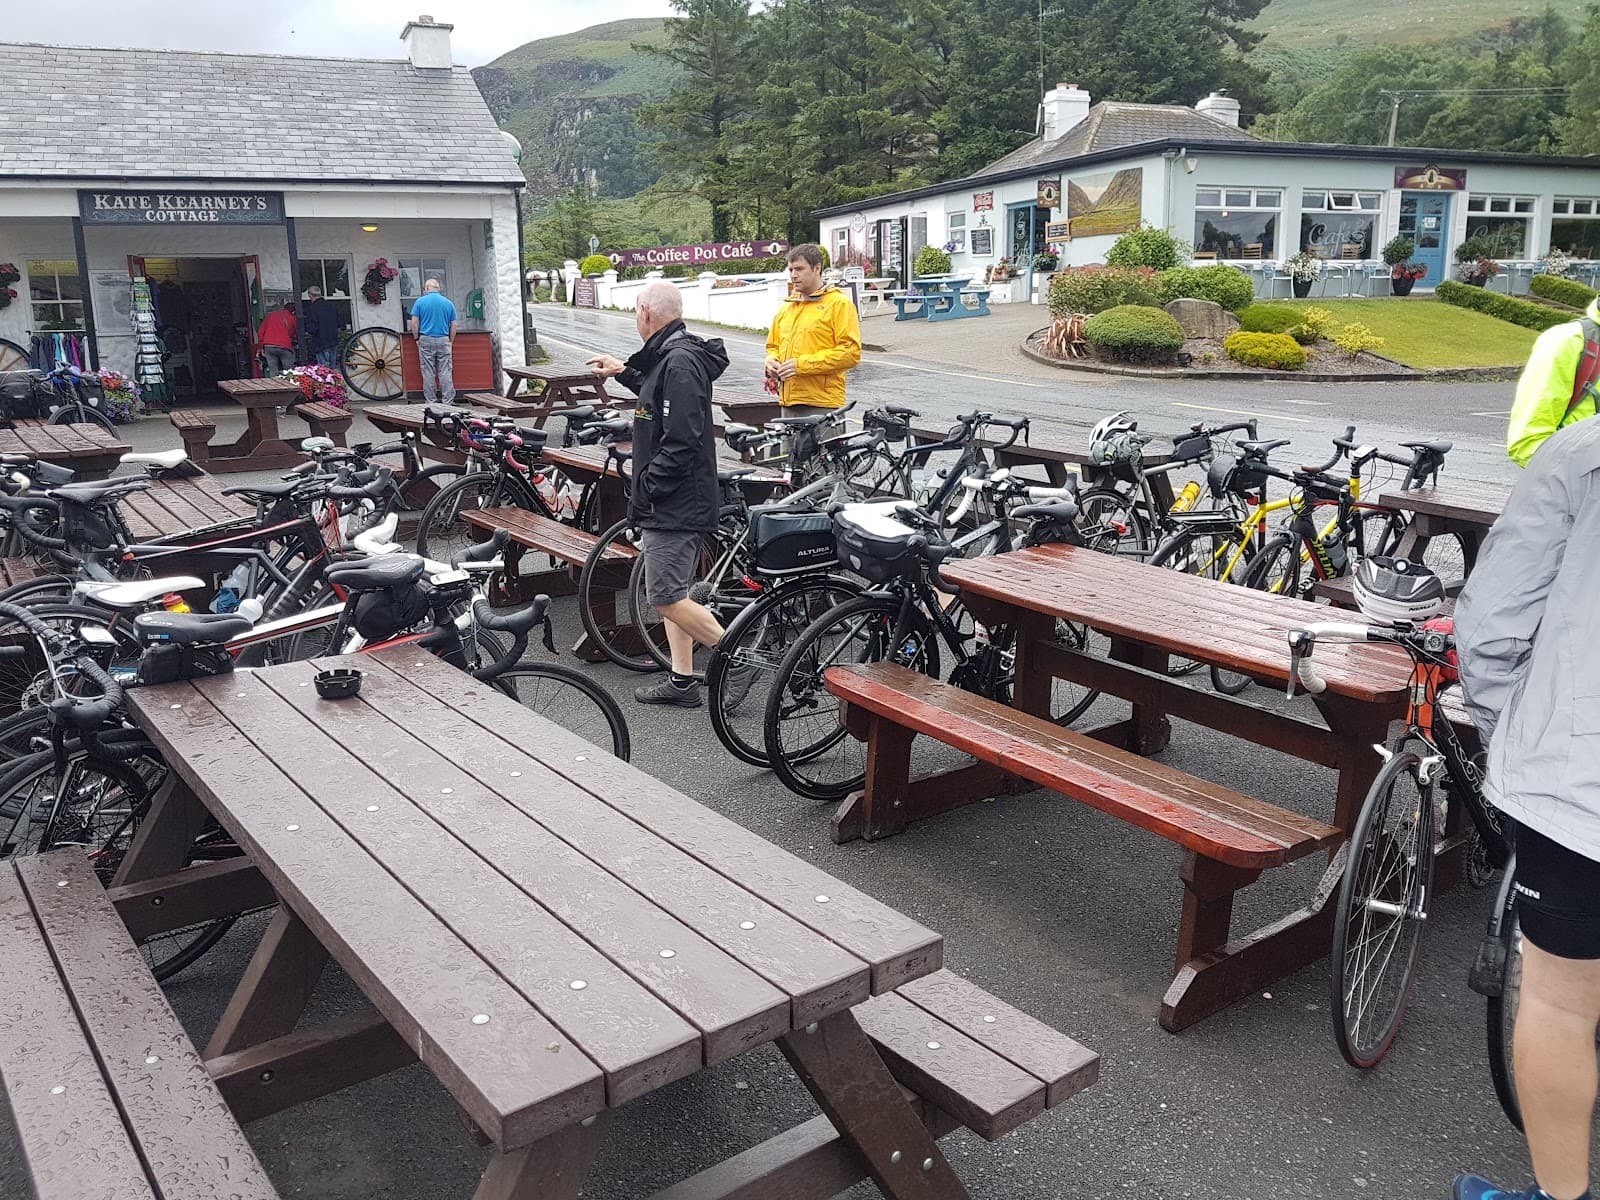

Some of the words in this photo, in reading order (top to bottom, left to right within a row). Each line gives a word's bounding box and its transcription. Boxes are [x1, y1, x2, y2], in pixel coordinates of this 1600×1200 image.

[92, 194, 152, 210] KATE
[156, 194, 267, 210] KEARNEY'S
[145, 210, 219, 222] COTTAGE
[631, 253, 646, 262] The
[646, 248, 690, 263] Coffee
[694, 247, 718, 260] Pot
[721, 243, 753, 259] Café
[797, 546, 830, 557] ALTURA
[1514, 881, 1541, 900] WIN
